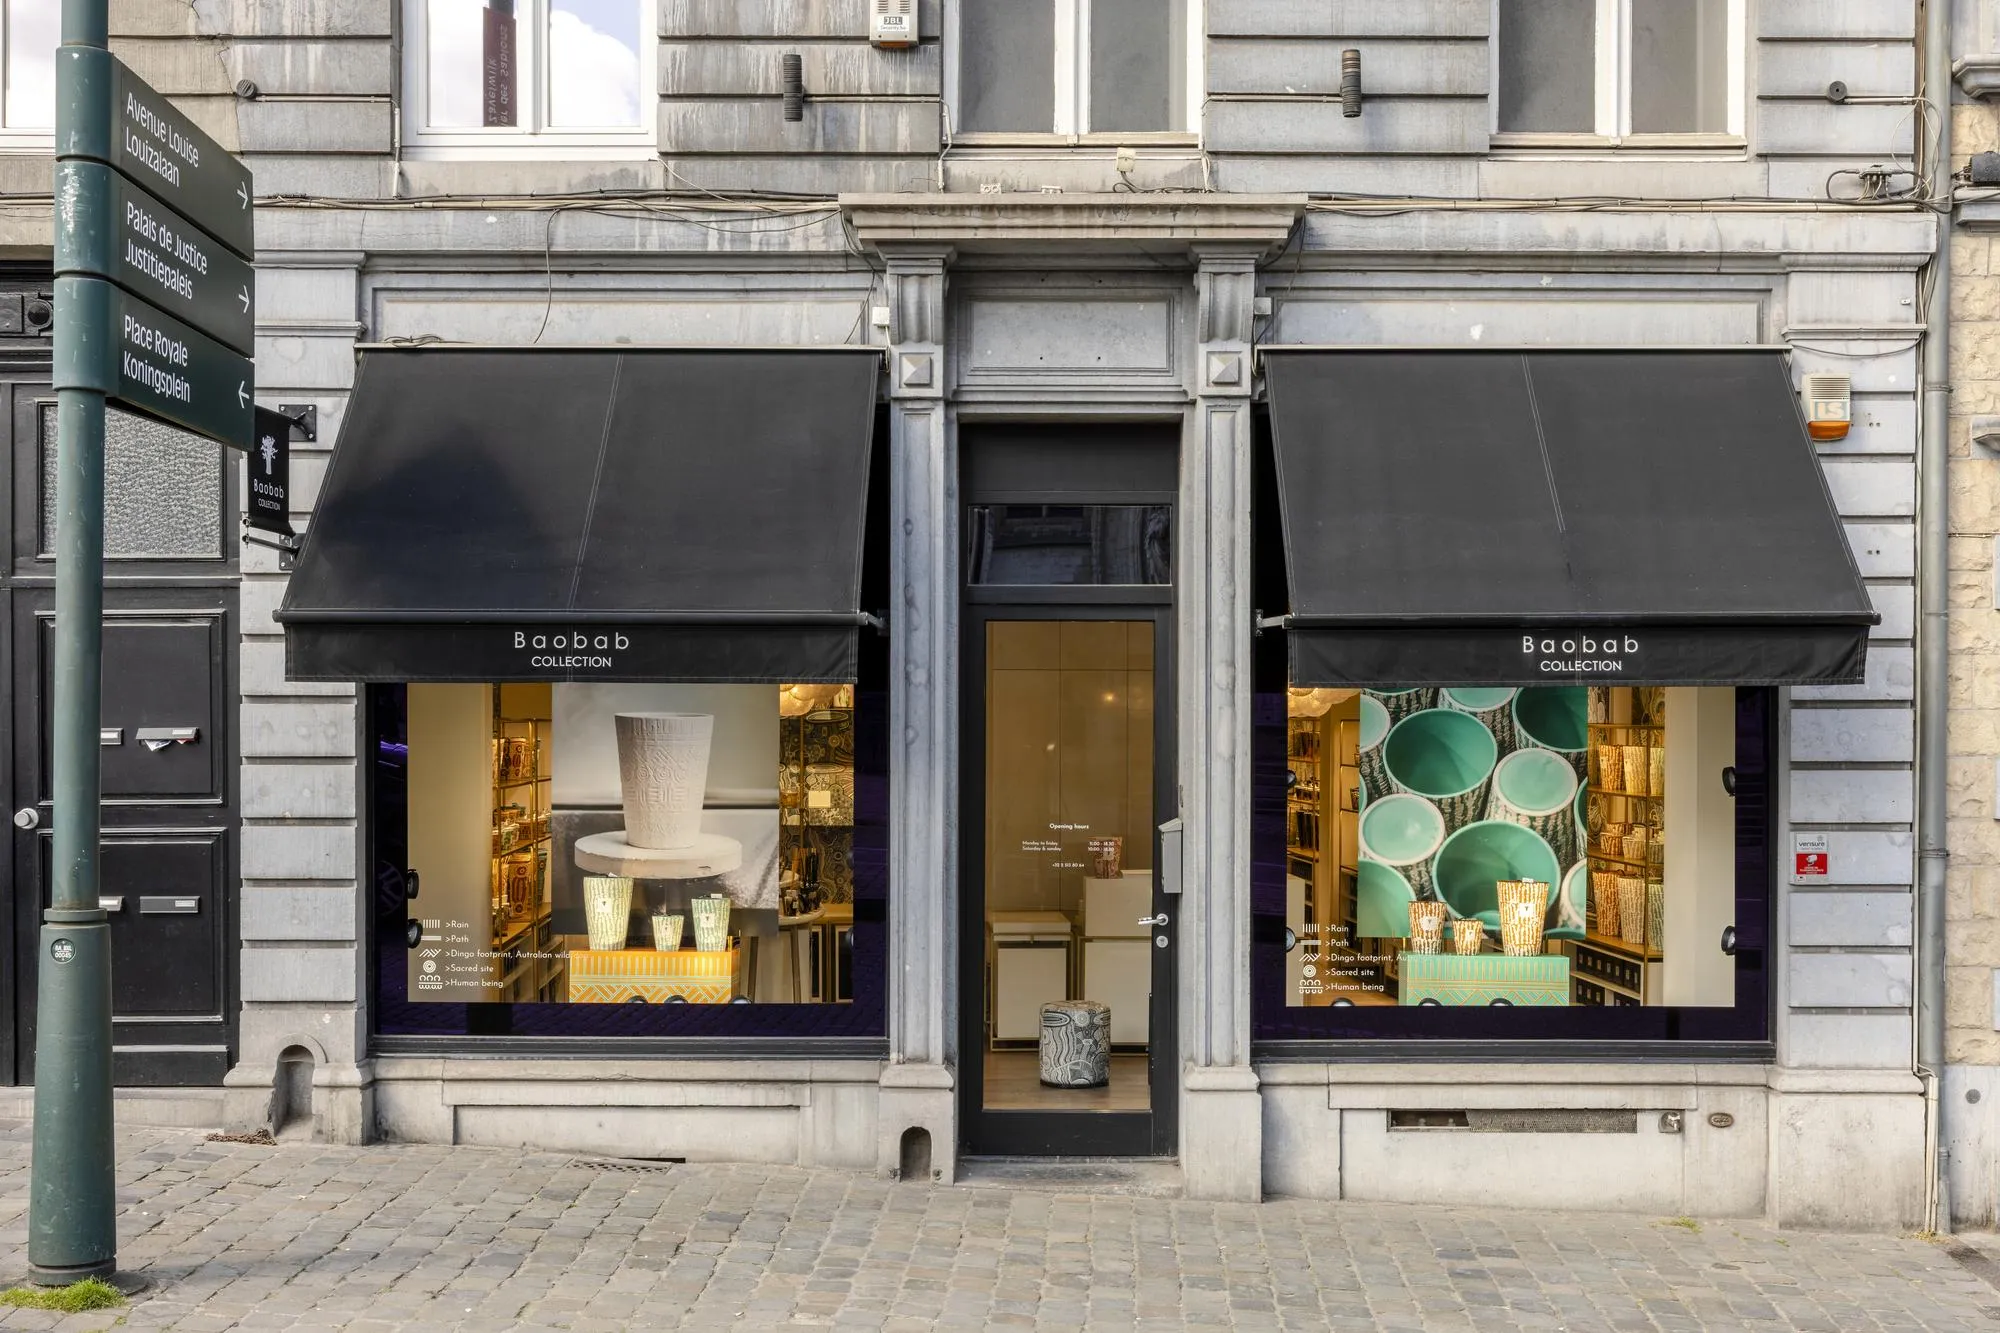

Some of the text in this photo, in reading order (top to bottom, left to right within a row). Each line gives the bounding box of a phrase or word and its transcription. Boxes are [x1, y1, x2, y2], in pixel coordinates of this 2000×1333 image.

[884, 16, 903, 25] JBL
[126, 92, 199, 168] Avenue Louise
[126, 126, 180, 188] Louizalaan
[127, 201, 208, 276] Palais de Justice
[125, 238, 193, 300] Justitiepaleis
[124, 315, 188, 367] Place Royale
[123, 351, 190, 403] Koningsplein
[253, 478, 284, 499] Baobab
[258, 498, 281, 511] COLLECTION
[514, 631, 629, 650] Baobab
[1522, 635, 1639, 654] Baobab
[531, 656, 612, 668] COLLECTION
[1540, 660, 1622, 672] COLLECTION
[480, 964, 494, 972] site
[1361, 968, 1375, 976] site
[482, 979, 504, 989] being
[1362, 983, 1385, 992] being
